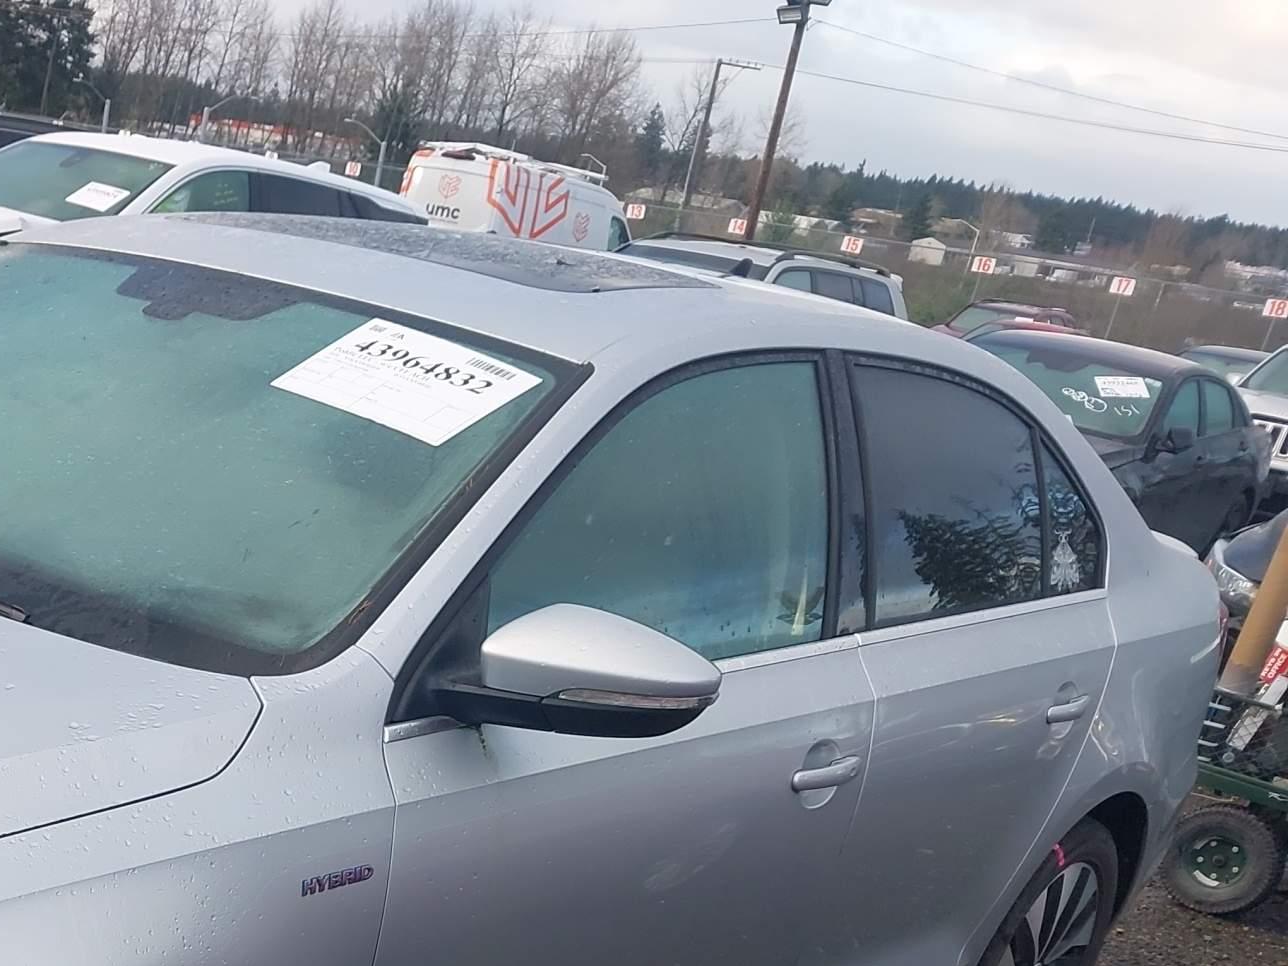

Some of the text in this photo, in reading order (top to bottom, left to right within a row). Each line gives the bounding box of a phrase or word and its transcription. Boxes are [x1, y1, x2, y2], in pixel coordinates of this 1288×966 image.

[426, 203, 461, 219] umc
[631, 204, 643, 218] 13
[732, 220, 746, 233] 14
[845, 237, 860, 252] 15
[976, 257, 992, 272] 16
[1117, 277, 1130, 295] 17
[1268, 299, 1286, 317] 18
[355, 340, 493, 394] 43964832
[301, 864, 374, 897] HYBRID
